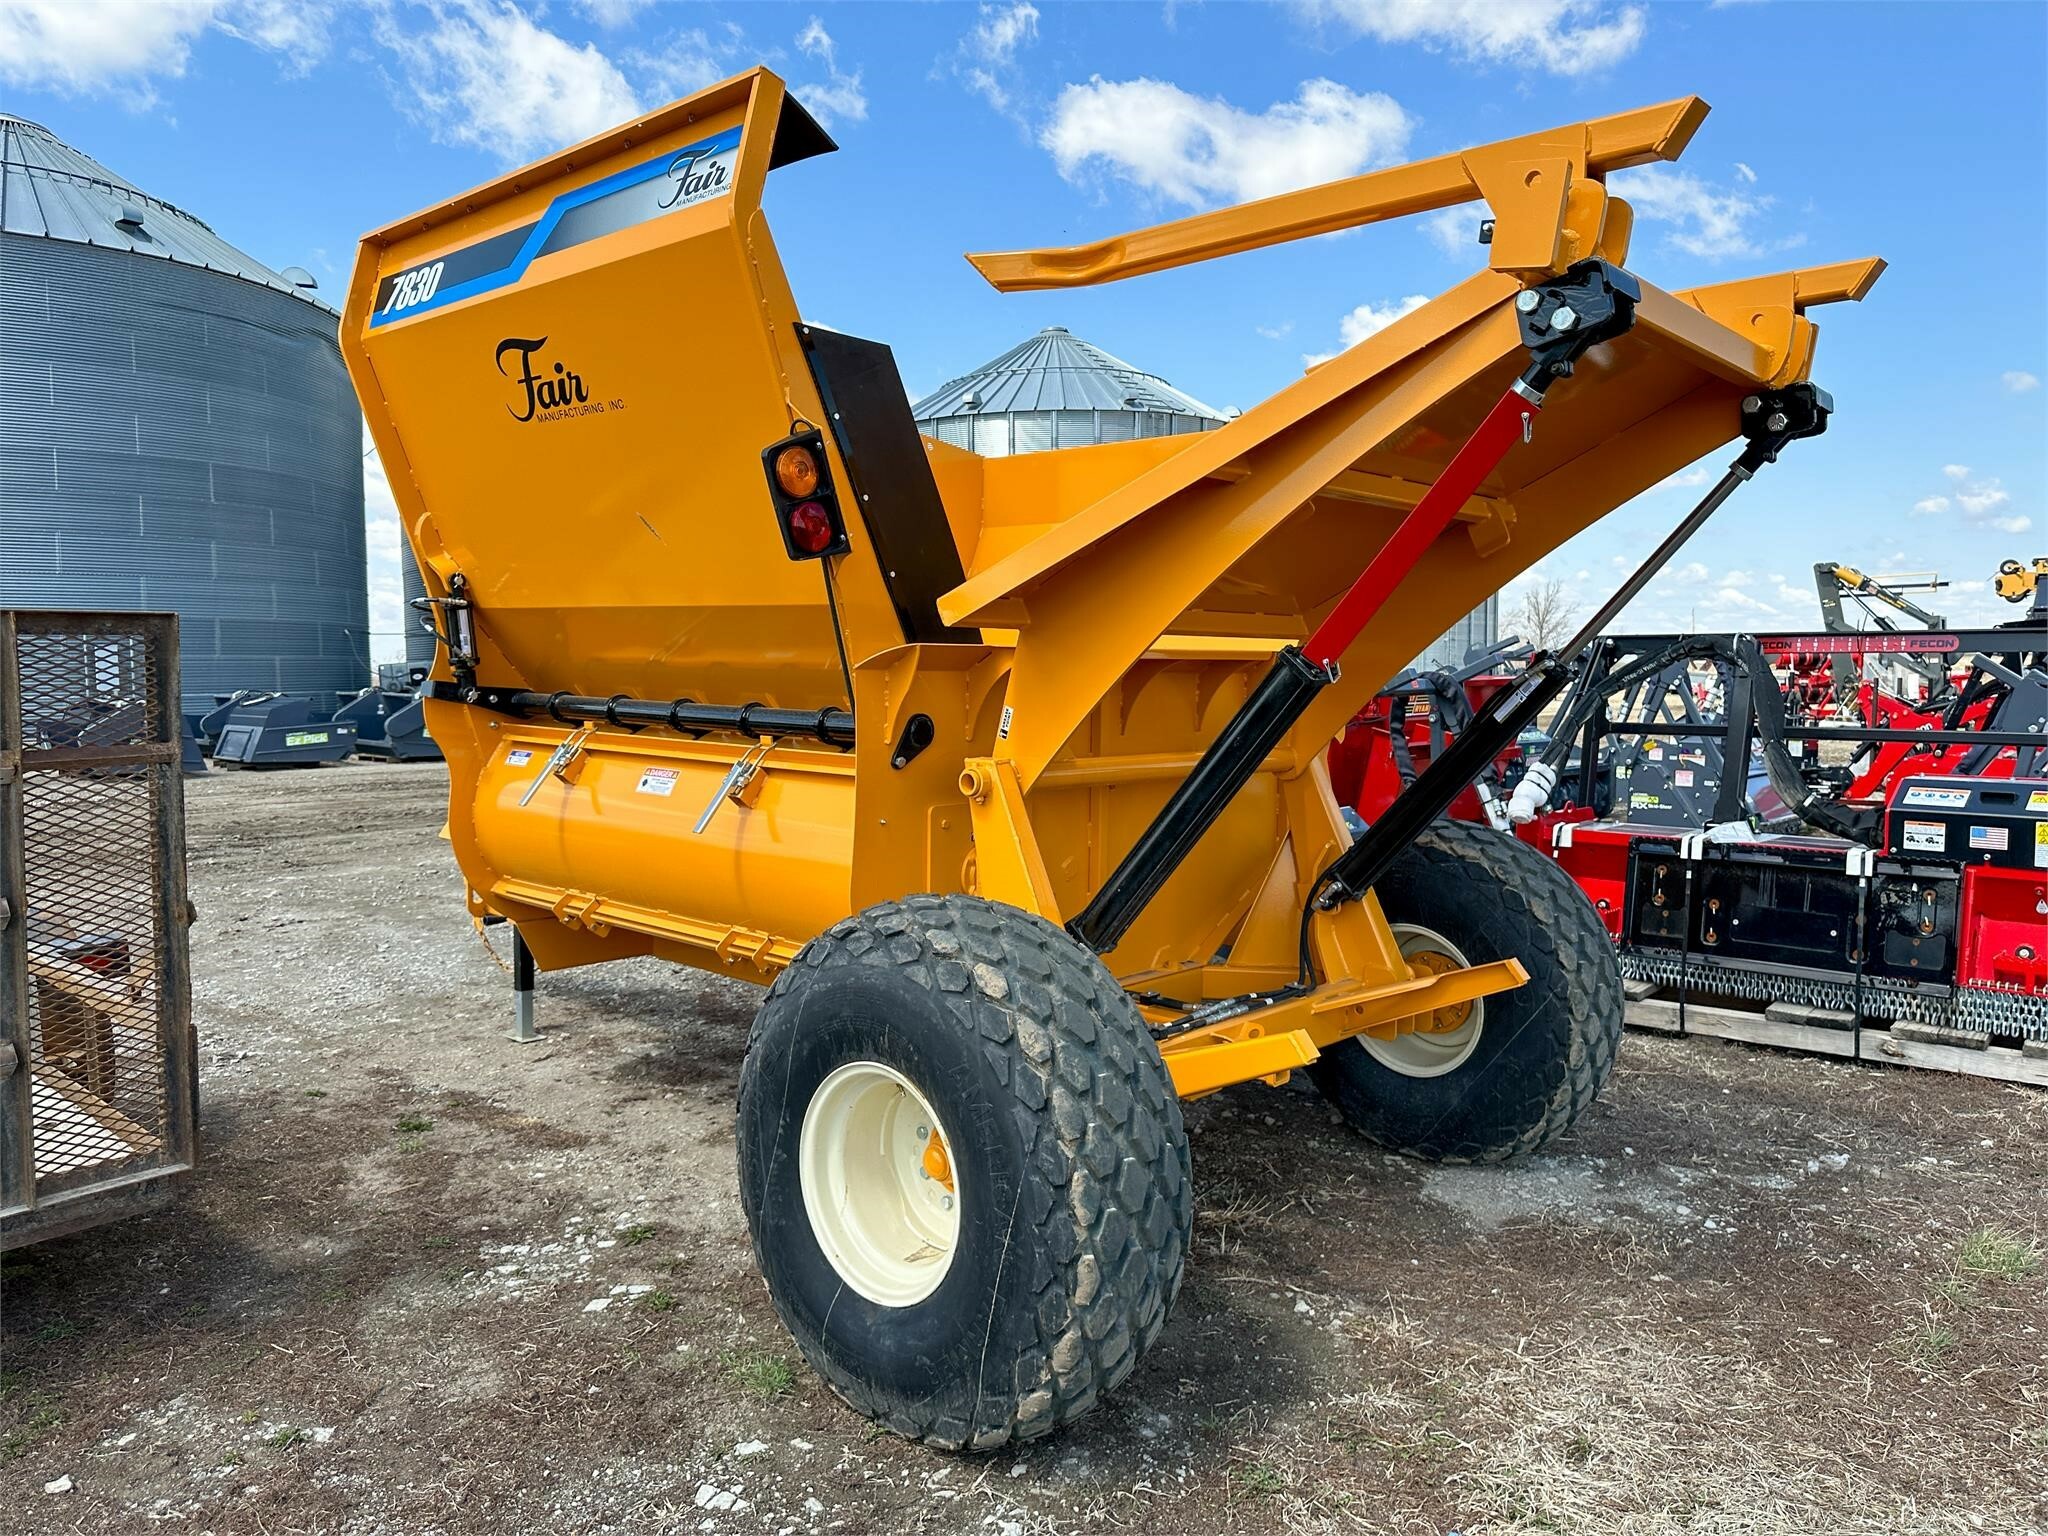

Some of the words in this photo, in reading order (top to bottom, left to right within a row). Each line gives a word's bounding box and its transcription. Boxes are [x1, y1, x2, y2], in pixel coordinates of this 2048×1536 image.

[658, 144, 729, 209] Fair
[675, 182, 732, 207] MANUFACTURING
[381, 261, 445, 316] 7830
[495, 335, 589, 423] Fair
[536, 402, 605, 423] MANUFACTURING
[608, 398, 628, 411] INC.
[1761, 641, 1792, 650] ECON
[1910, 640, 1955, 648] FECON
[650, 769, 673, 778] DANGER
